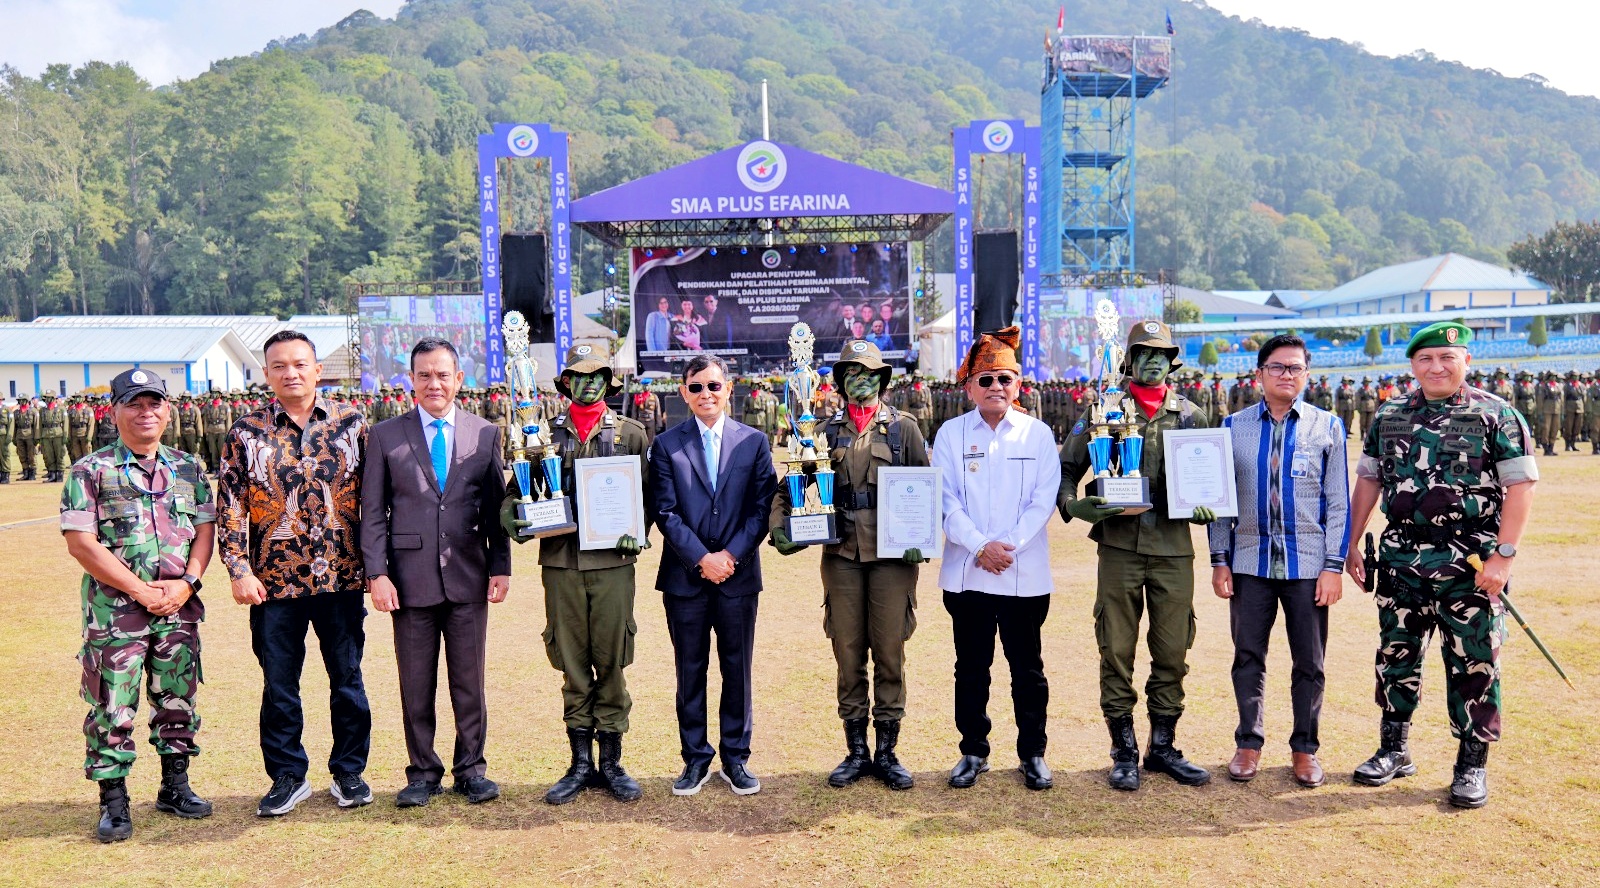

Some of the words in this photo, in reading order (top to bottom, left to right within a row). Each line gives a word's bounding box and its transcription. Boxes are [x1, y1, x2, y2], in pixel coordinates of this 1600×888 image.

[483, 175, 493, 213] SMA
[555, 172, 566, 209] SMA
[671, 198, 712, 214] SMA
[717, 196, 764, 212] PLUS
[770, 194, 850, 211] EFARINA
[957, 167, 968, 204] SMA
[1027, 166, 1037, 203] SMA
[486, 225, 496, 278] PLUS
[557, 222, 567, 275] PLUS
[959, 217, 968, 269] PLUS
[1027, 216, 1037, 268] PLUS
[677, 281, 725, 289] PENDIDIKAN
[744, 279, 787, 287] PELATIHAN
[788, 278, 835, 286] PEMBINAAN
[835, 277, 869, 285] MENTAL,
[718, 289, 741, 297] FISIK,
[759, 288, 792, 296] DISIPLIN
[792, 286, 830, 295] TARUNA/I
[768, 270, 816, 278] PENUTUPAN
[488, 293, 501, 386] EFARIN
[558, 289, 569, 373] EFARI
[959, 284, 970, 368] EFARI
[1026, 282, 1037, 382] EFARINA
